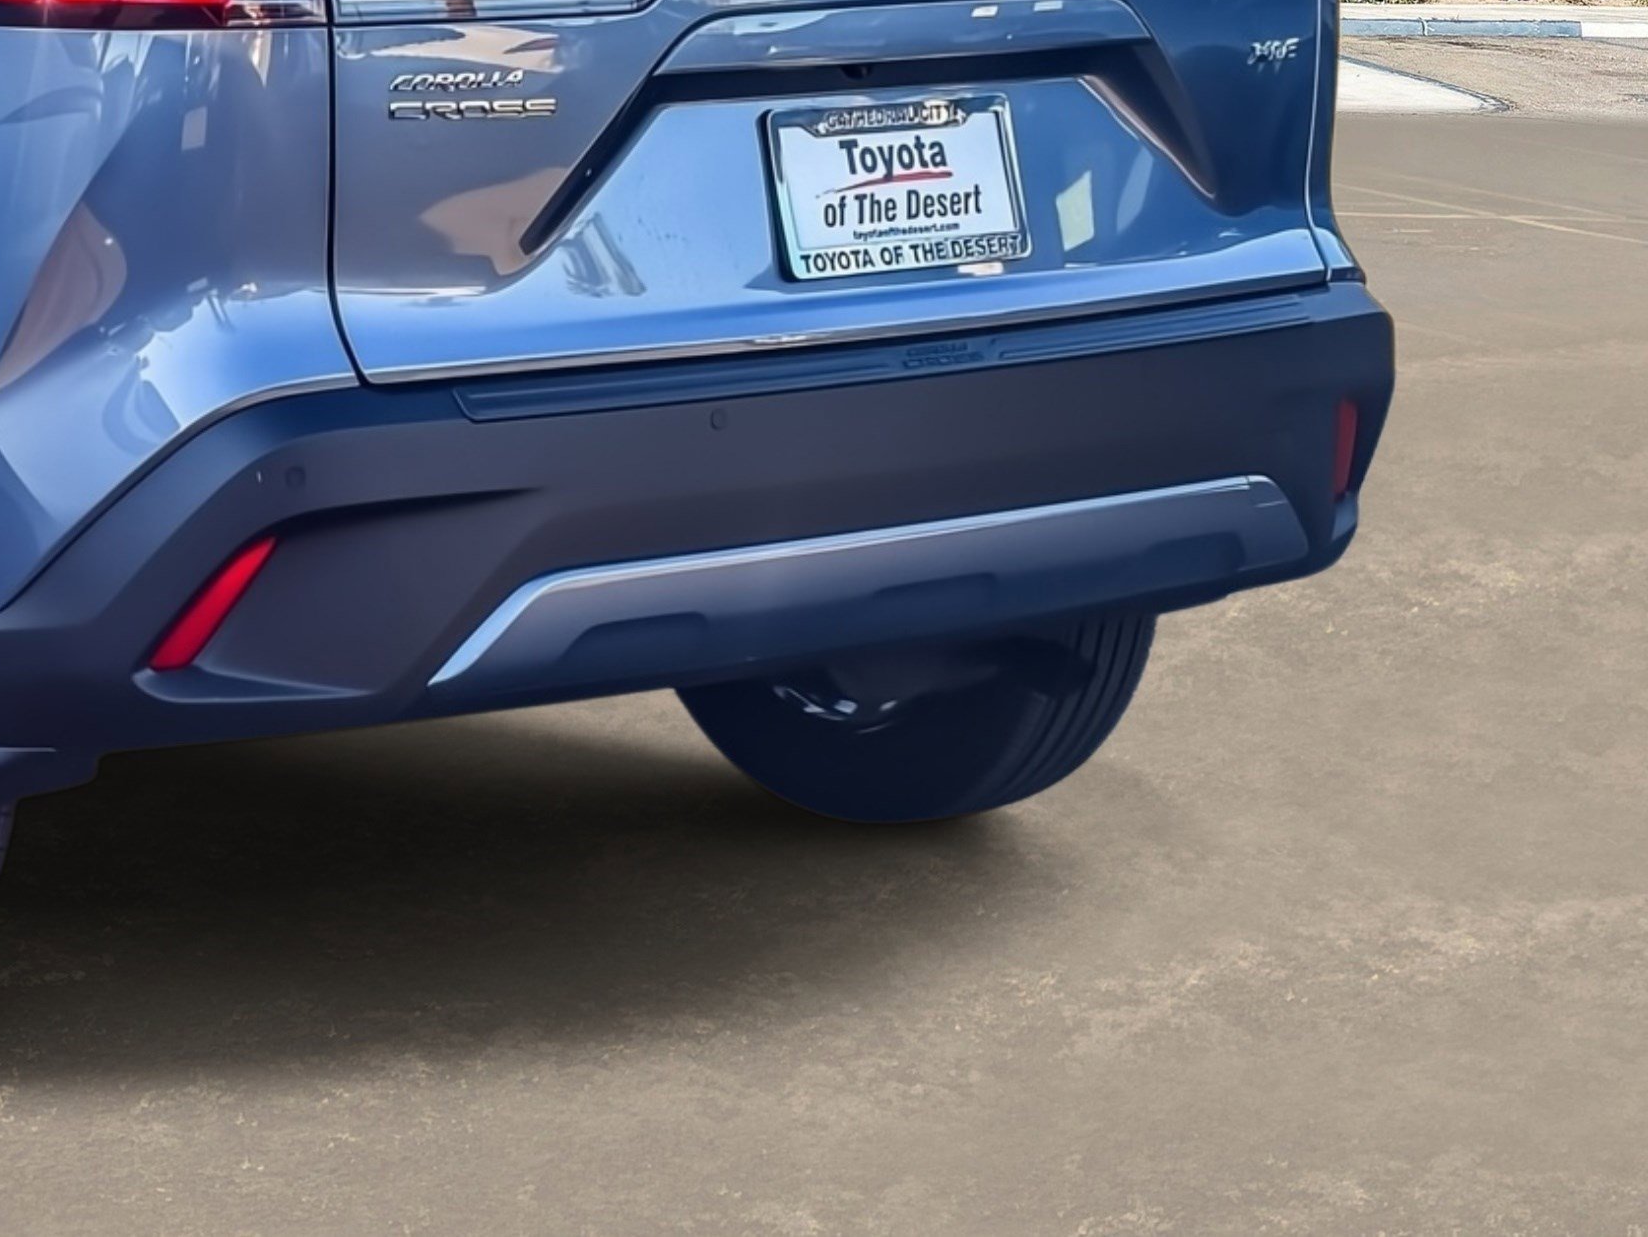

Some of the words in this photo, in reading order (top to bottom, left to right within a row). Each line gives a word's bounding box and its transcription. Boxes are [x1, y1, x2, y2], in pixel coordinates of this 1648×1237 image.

[389, 69, 524, 91] COROLLA
[388, 98, 557, 120] CROSS
[838, 135, 948, 178] Toyota
[823, 195, 847, 228] of
[854, 193, 898, 225] The
[906, 184, 982, 220] Desert
[800, 248, 875, 274] TOYOTA
[880, 245, 904, 266] OF
[909, 241, 948, 262] THE
[950, 234, 1021, 260] DESERT
